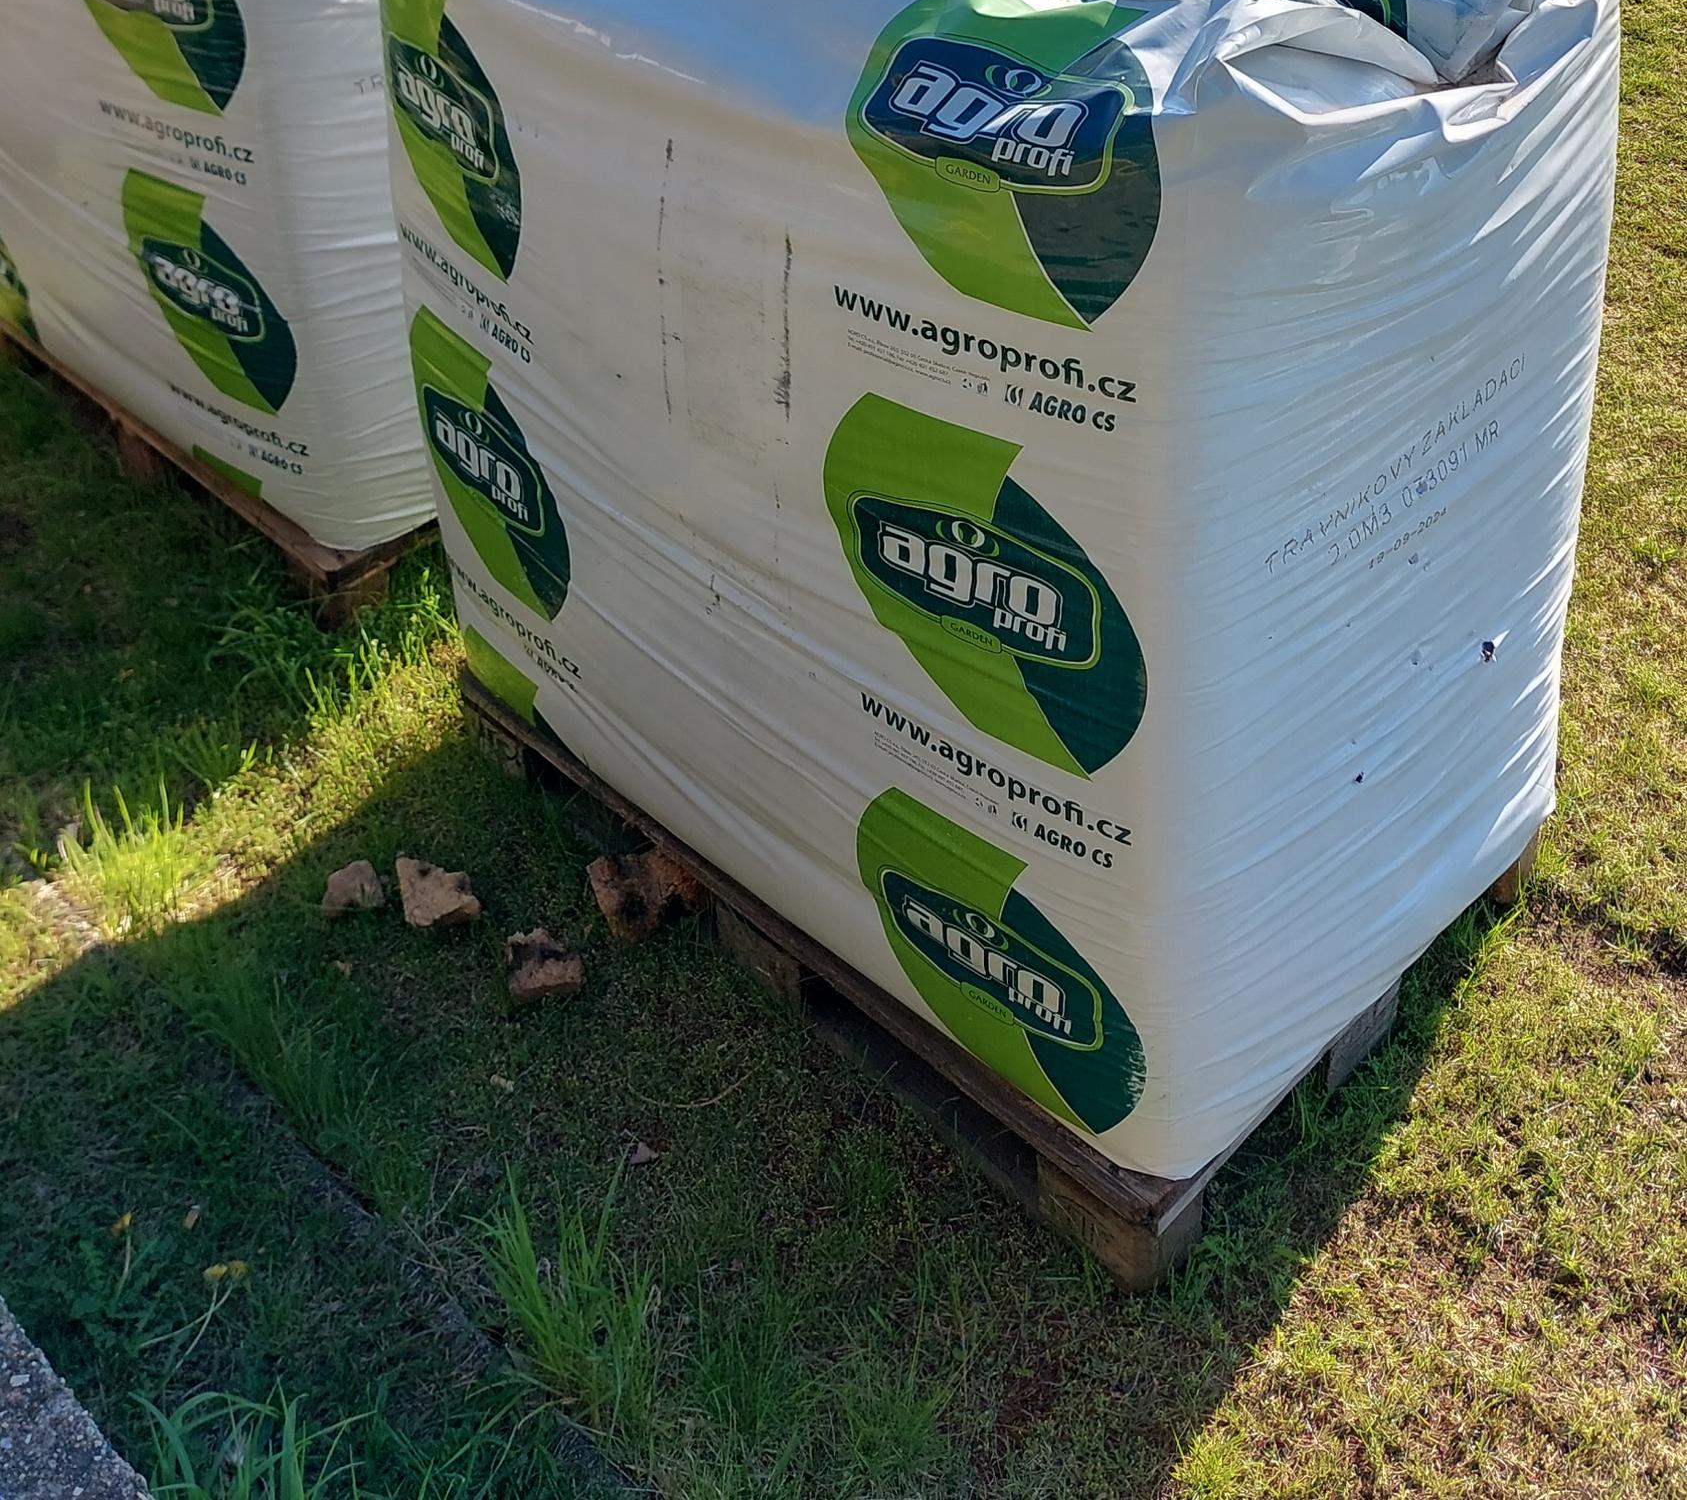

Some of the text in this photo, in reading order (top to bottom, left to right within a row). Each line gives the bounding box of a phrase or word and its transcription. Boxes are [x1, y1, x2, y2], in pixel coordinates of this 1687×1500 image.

[398, 61, 478, 148] agro
[890, 61, 1086, 143] agro
[100, 100, 254, 163] www.agroprofi.cz
[450, 132, 485, 171] profi
[204, 160, 248, 186] AGRO CS
[945, 163, 992, 185] GARDEN
[991, 137, 1075, 177] profi
[152, 253, 240, 316] agro
[210, 306, 249, 333] profi
[491, 323, 520, 354] AGRO
[834, 284, 1137, 404] www.agroprofi.cz
[1029, 391, 1117, 433] AGRO CS
[436, 409, 523, 501] agro
[491, 484, 529, 522] profi
[881, 521, 1061, 627] agro
[448, 556, 583, 681] ww.agroprofi.cz
[949, 621, 993, 648] GARDEN
[993, 607, 1068, 652] profi
[860, 691, 1133, 847] www.agroprofi.cz
[1034, 823, 1114, 869] AGRO CS
[903, 897, 1064, 1015] agro
[1008, 986, 1073, 1036] profi
